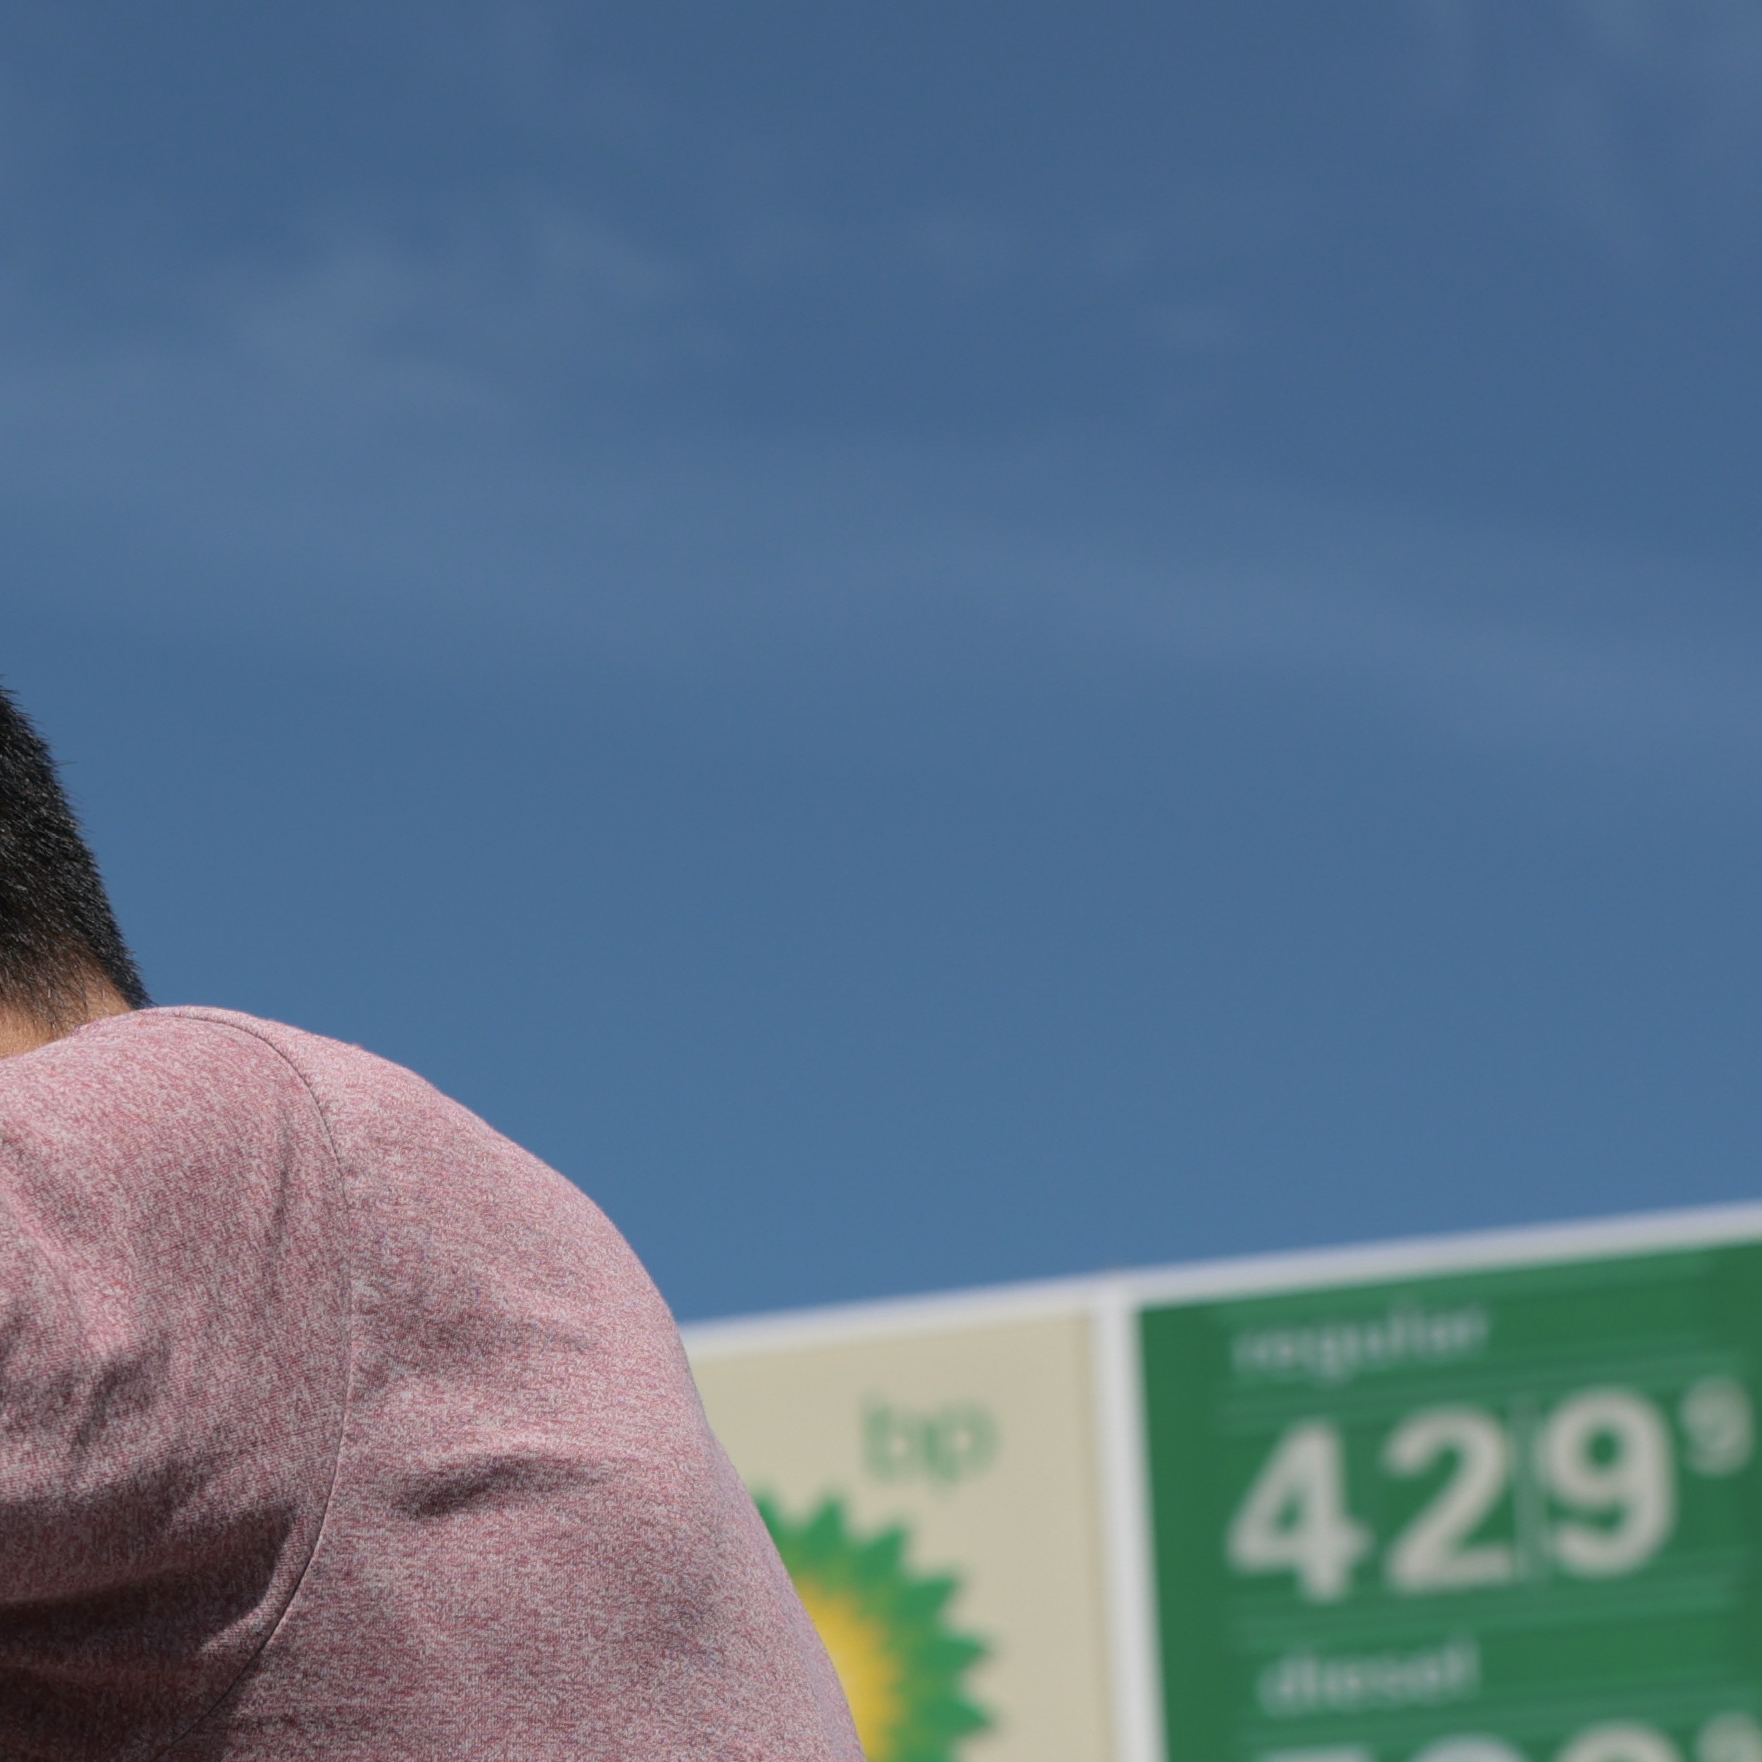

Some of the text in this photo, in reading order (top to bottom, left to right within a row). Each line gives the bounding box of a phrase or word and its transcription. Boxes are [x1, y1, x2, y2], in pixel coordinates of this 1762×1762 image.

[1234, 1308, 1488, 1382] regular
[864, 1396, 999, 1493] bp
[1261, 1642, 1478, 1715] diesel
